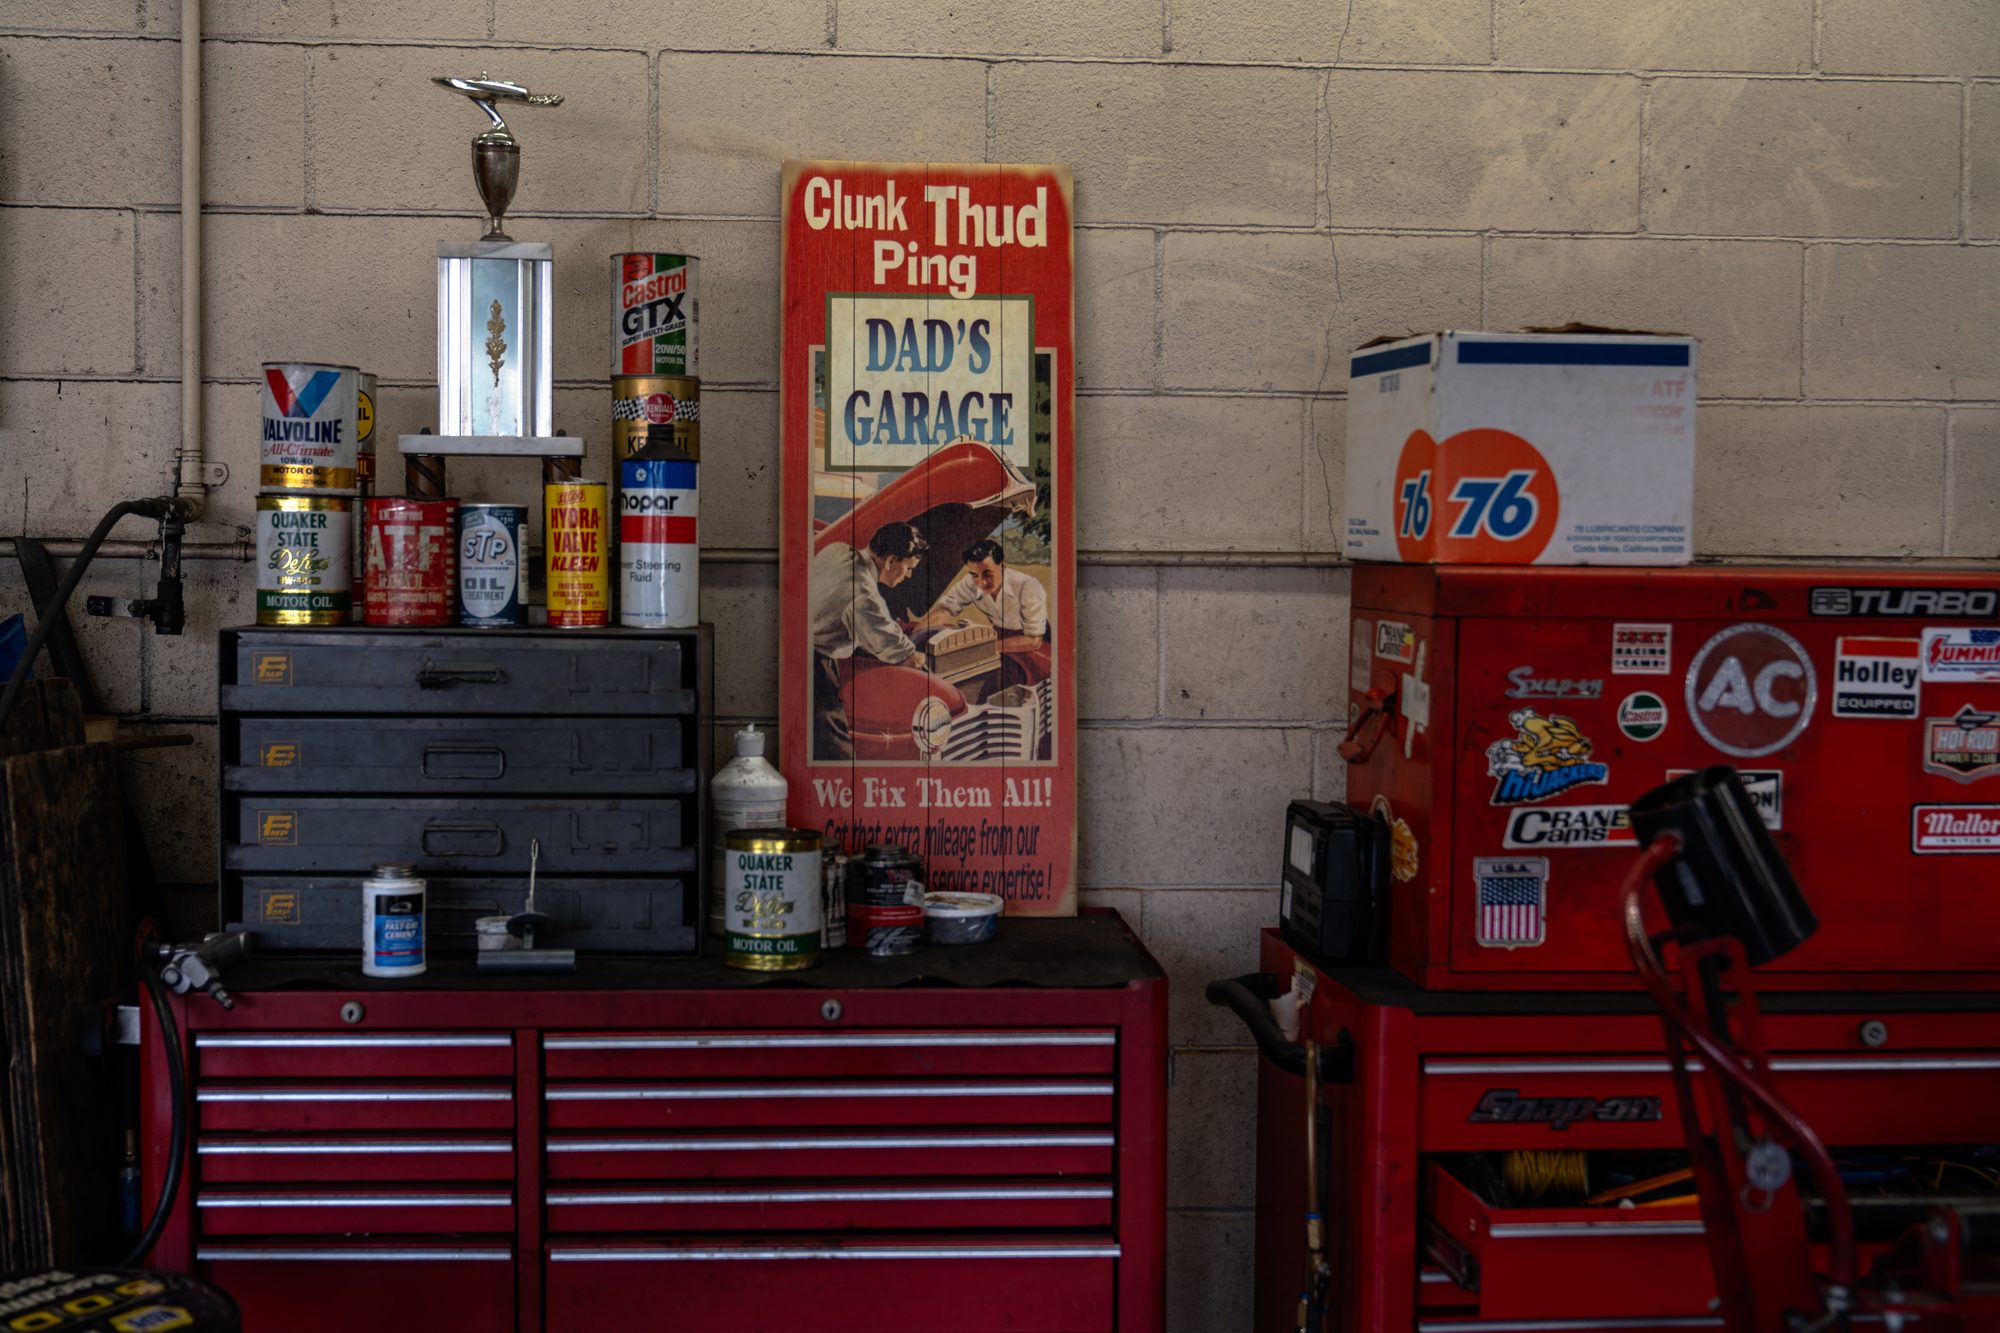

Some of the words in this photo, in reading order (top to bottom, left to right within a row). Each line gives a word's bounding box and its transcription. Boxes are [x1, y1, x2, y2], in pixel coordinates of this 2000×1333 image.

[804, 176, 909, 231] Clunk
[925, 185, 1048, 247] Thud
[873, 240, 977, 299] Ping
[623, 267, 687, 309] Castrol
[622, 292, 686, 336] GTX
[865, 317, 991, 374] DAD'S
[263, 417, 343, 444] VALVOLINE
[844, 390, 1014, 446] GARAGE
[1400, 471, 1432, 540] 76
[1448, 470, 1537, 541] 76
[272, 513, 327, 529] QUAKER
[278, 532, 319, 547] STATE
[366, 524, 446, 573] ATF
[464, 530, 507, 563] STP
[553, 532, 597, 552] VALVE
[551, 556, 600, 571] KLEEN
[636, 559, 681, 572] Steering
[464, 578, 505, 590] OIL
[629, 573, 652, 582] Fluid
[266, 595, 308, 608] MOTOR
[312, 596, 333, 608] OIL
[1853, 589, 1998, 616] TURBO
[1698, 656, 1803, 718] AC
[1838, 661, 1918, 689] Holley
[1838, 697, 1915, 710] EQUIPPED
[1967, 731, 1996, 751] ROD
[812, 778, 853, 808] We
[862, 777, 906, 808] Fix
[916, 778, 992, 808] Them
[1002, 777, 1053, 808] All!
[1924, 813, 2000, 835] Mallor
[924, 818, 976, 868] mileage
[980, 818, 1012, 856] from
[1016, 825, 1040, 856] our
[738, 855, 793, 871] QUAKER
[744, 874, 784, 890] STATE
[732, 939, 773, 951] MOTOR
[776, 940, 798, 952] OIL
[1468, 1089, 1663, 1130] Snap-on
